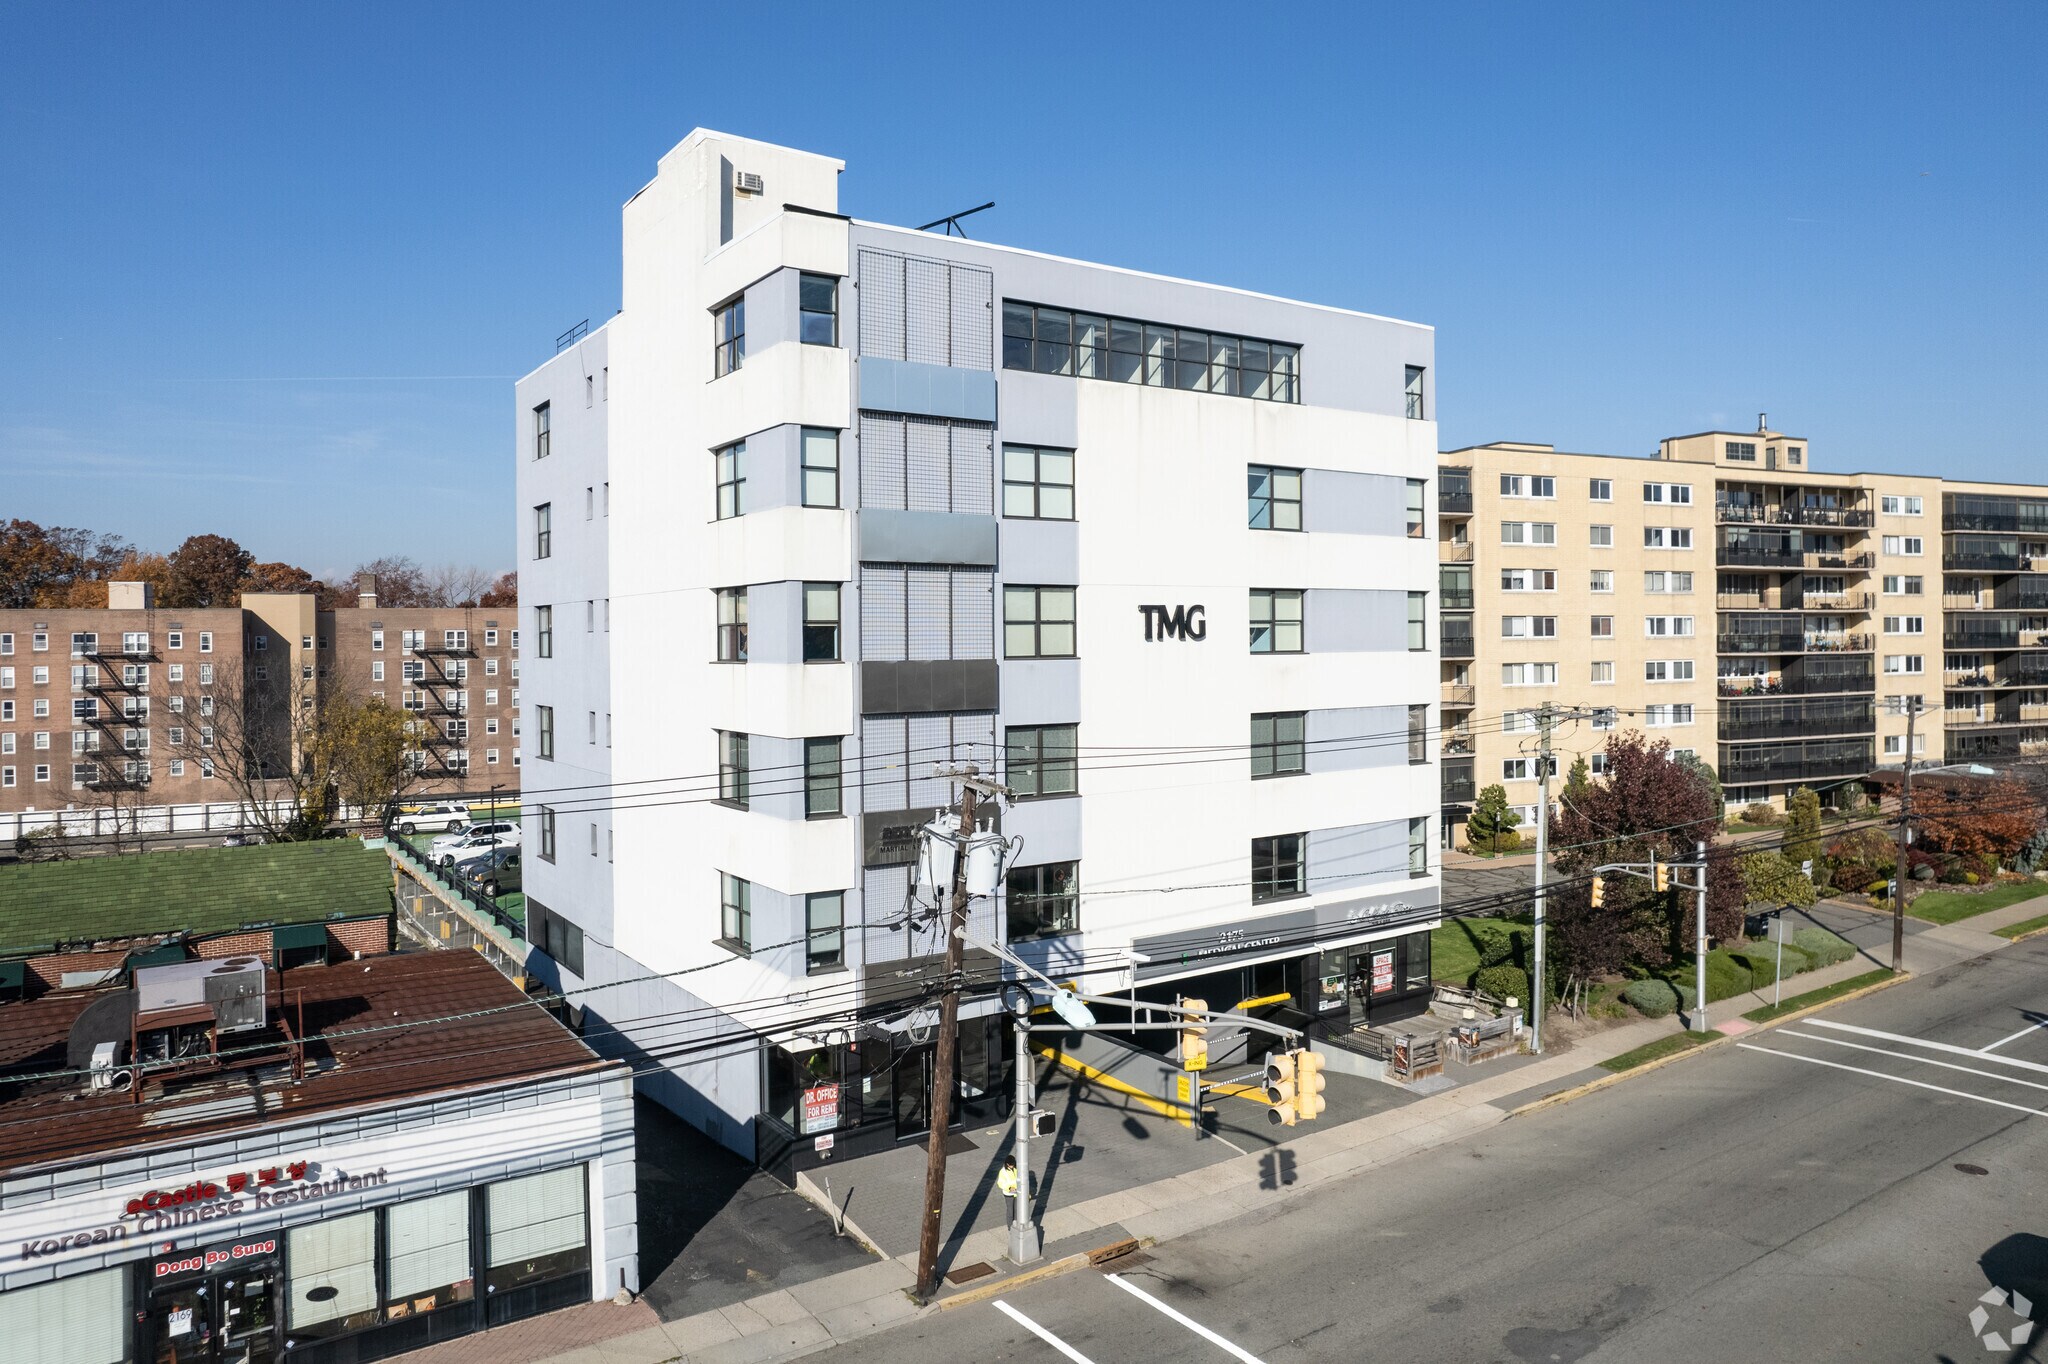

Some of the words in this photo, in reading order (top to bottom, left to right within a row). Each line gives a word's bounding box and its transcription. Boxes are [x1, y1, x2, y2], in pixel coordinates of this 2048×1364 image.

[1138, 604, 1207, 642] TMG
[880, 844, 908, 854] MARTIAL
[1219, 929, 1244, 943] 2175
[806, 1091, 816, 1105] DR.
[816, 1088, 838, 1102] OFFICE
[808, 1106, 820, 1118] FOR
[821, 1103, 837, 1115] RENT
[126, 1180, 218, 1214] eCastle
[22, 1224, 127, 1260] Korean
[138, 1198, 244, 1236] Chinese
[255, 1167, 388, 1209] Restaurant
[155, 1256, 203, 1277] Dong
[205, 1251, 230, 1265] Bo
[232, 1240, 276, 1258] Sung
[169, 1308, 192, 1323] 2169
